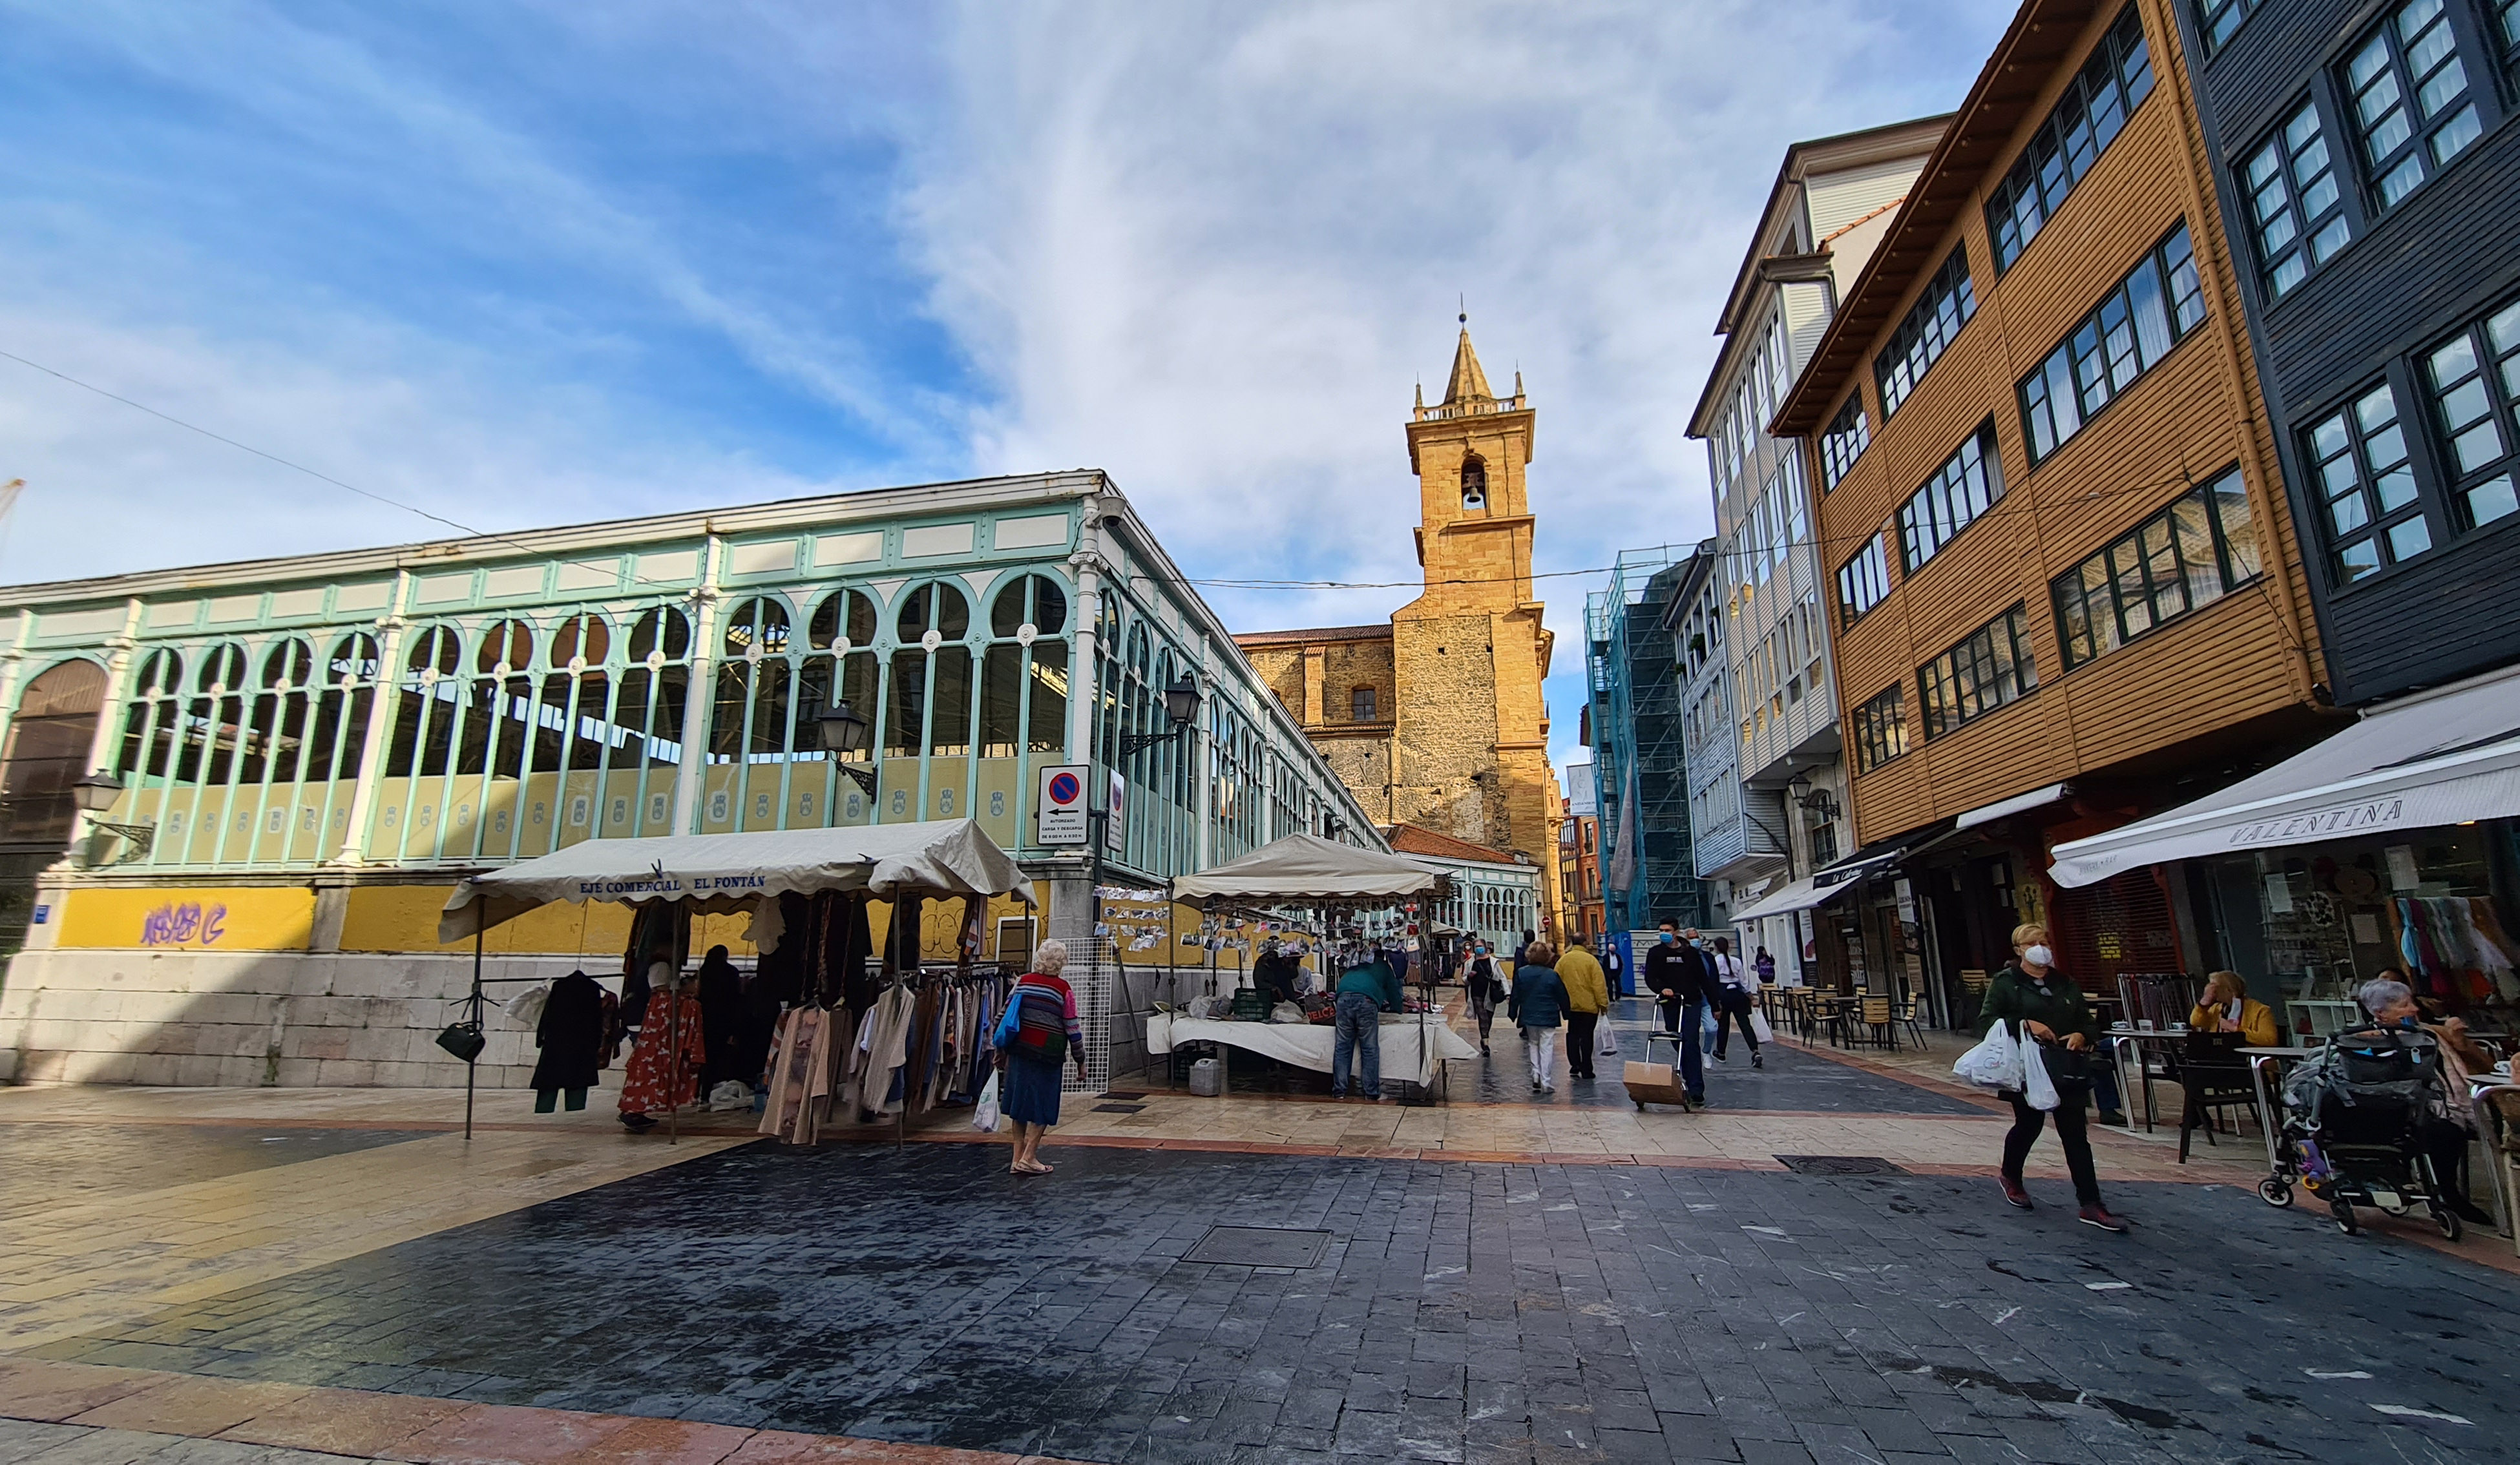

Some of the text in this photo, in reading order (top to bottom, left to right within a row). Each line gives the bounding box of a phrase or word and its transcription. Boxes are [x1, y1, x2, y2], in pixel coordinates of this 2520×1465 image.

[2230, 800, 2403, 844] VALENTINA
[580, 872, 766, 894] EJE COMERCIAL EL FONTÁN
